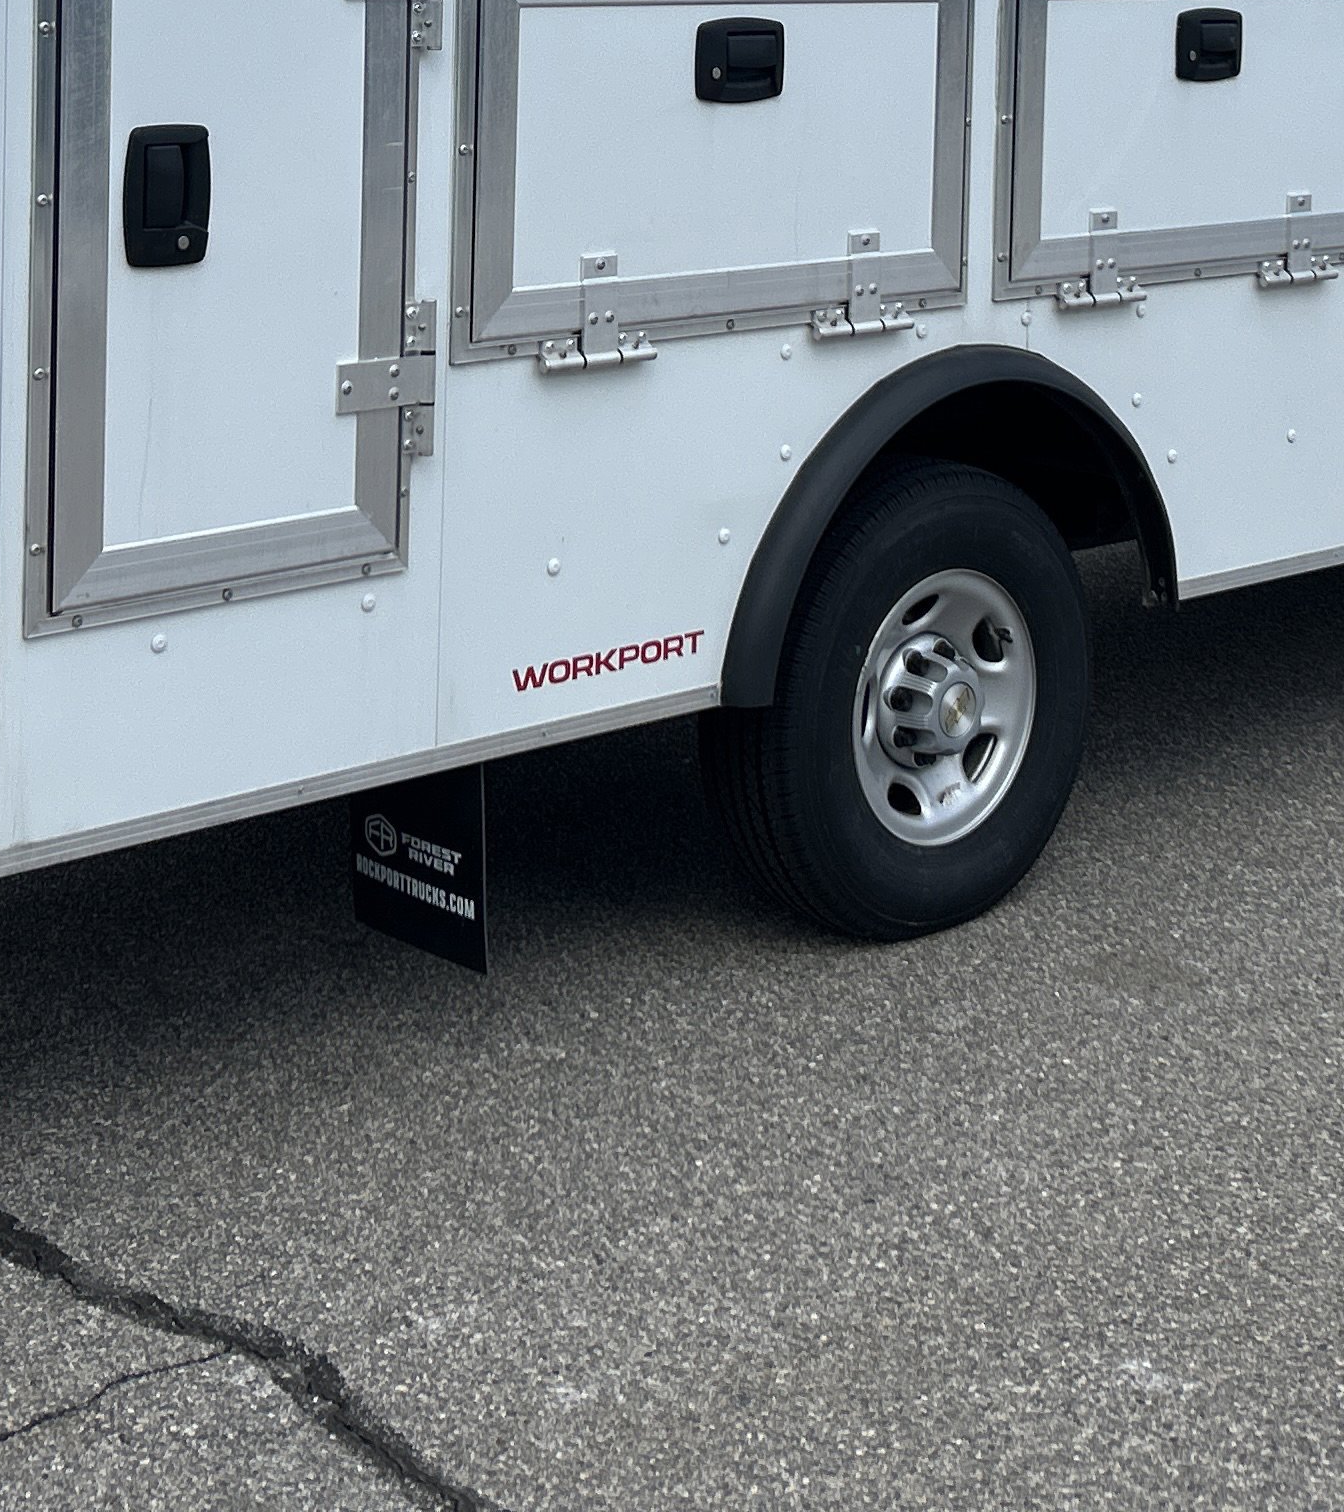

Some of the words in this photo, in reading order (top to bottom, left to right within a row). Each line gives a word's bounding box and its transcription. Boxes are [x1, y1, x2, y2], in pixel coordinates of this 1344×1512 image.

[511, 629, 705, 692] WORKPORT
[401, 832, 462, 865] FOREST
[408, 847, 455, 877] RIVER
[356, 852, 475, 920] ROCKPORTTRUCKS.COM
